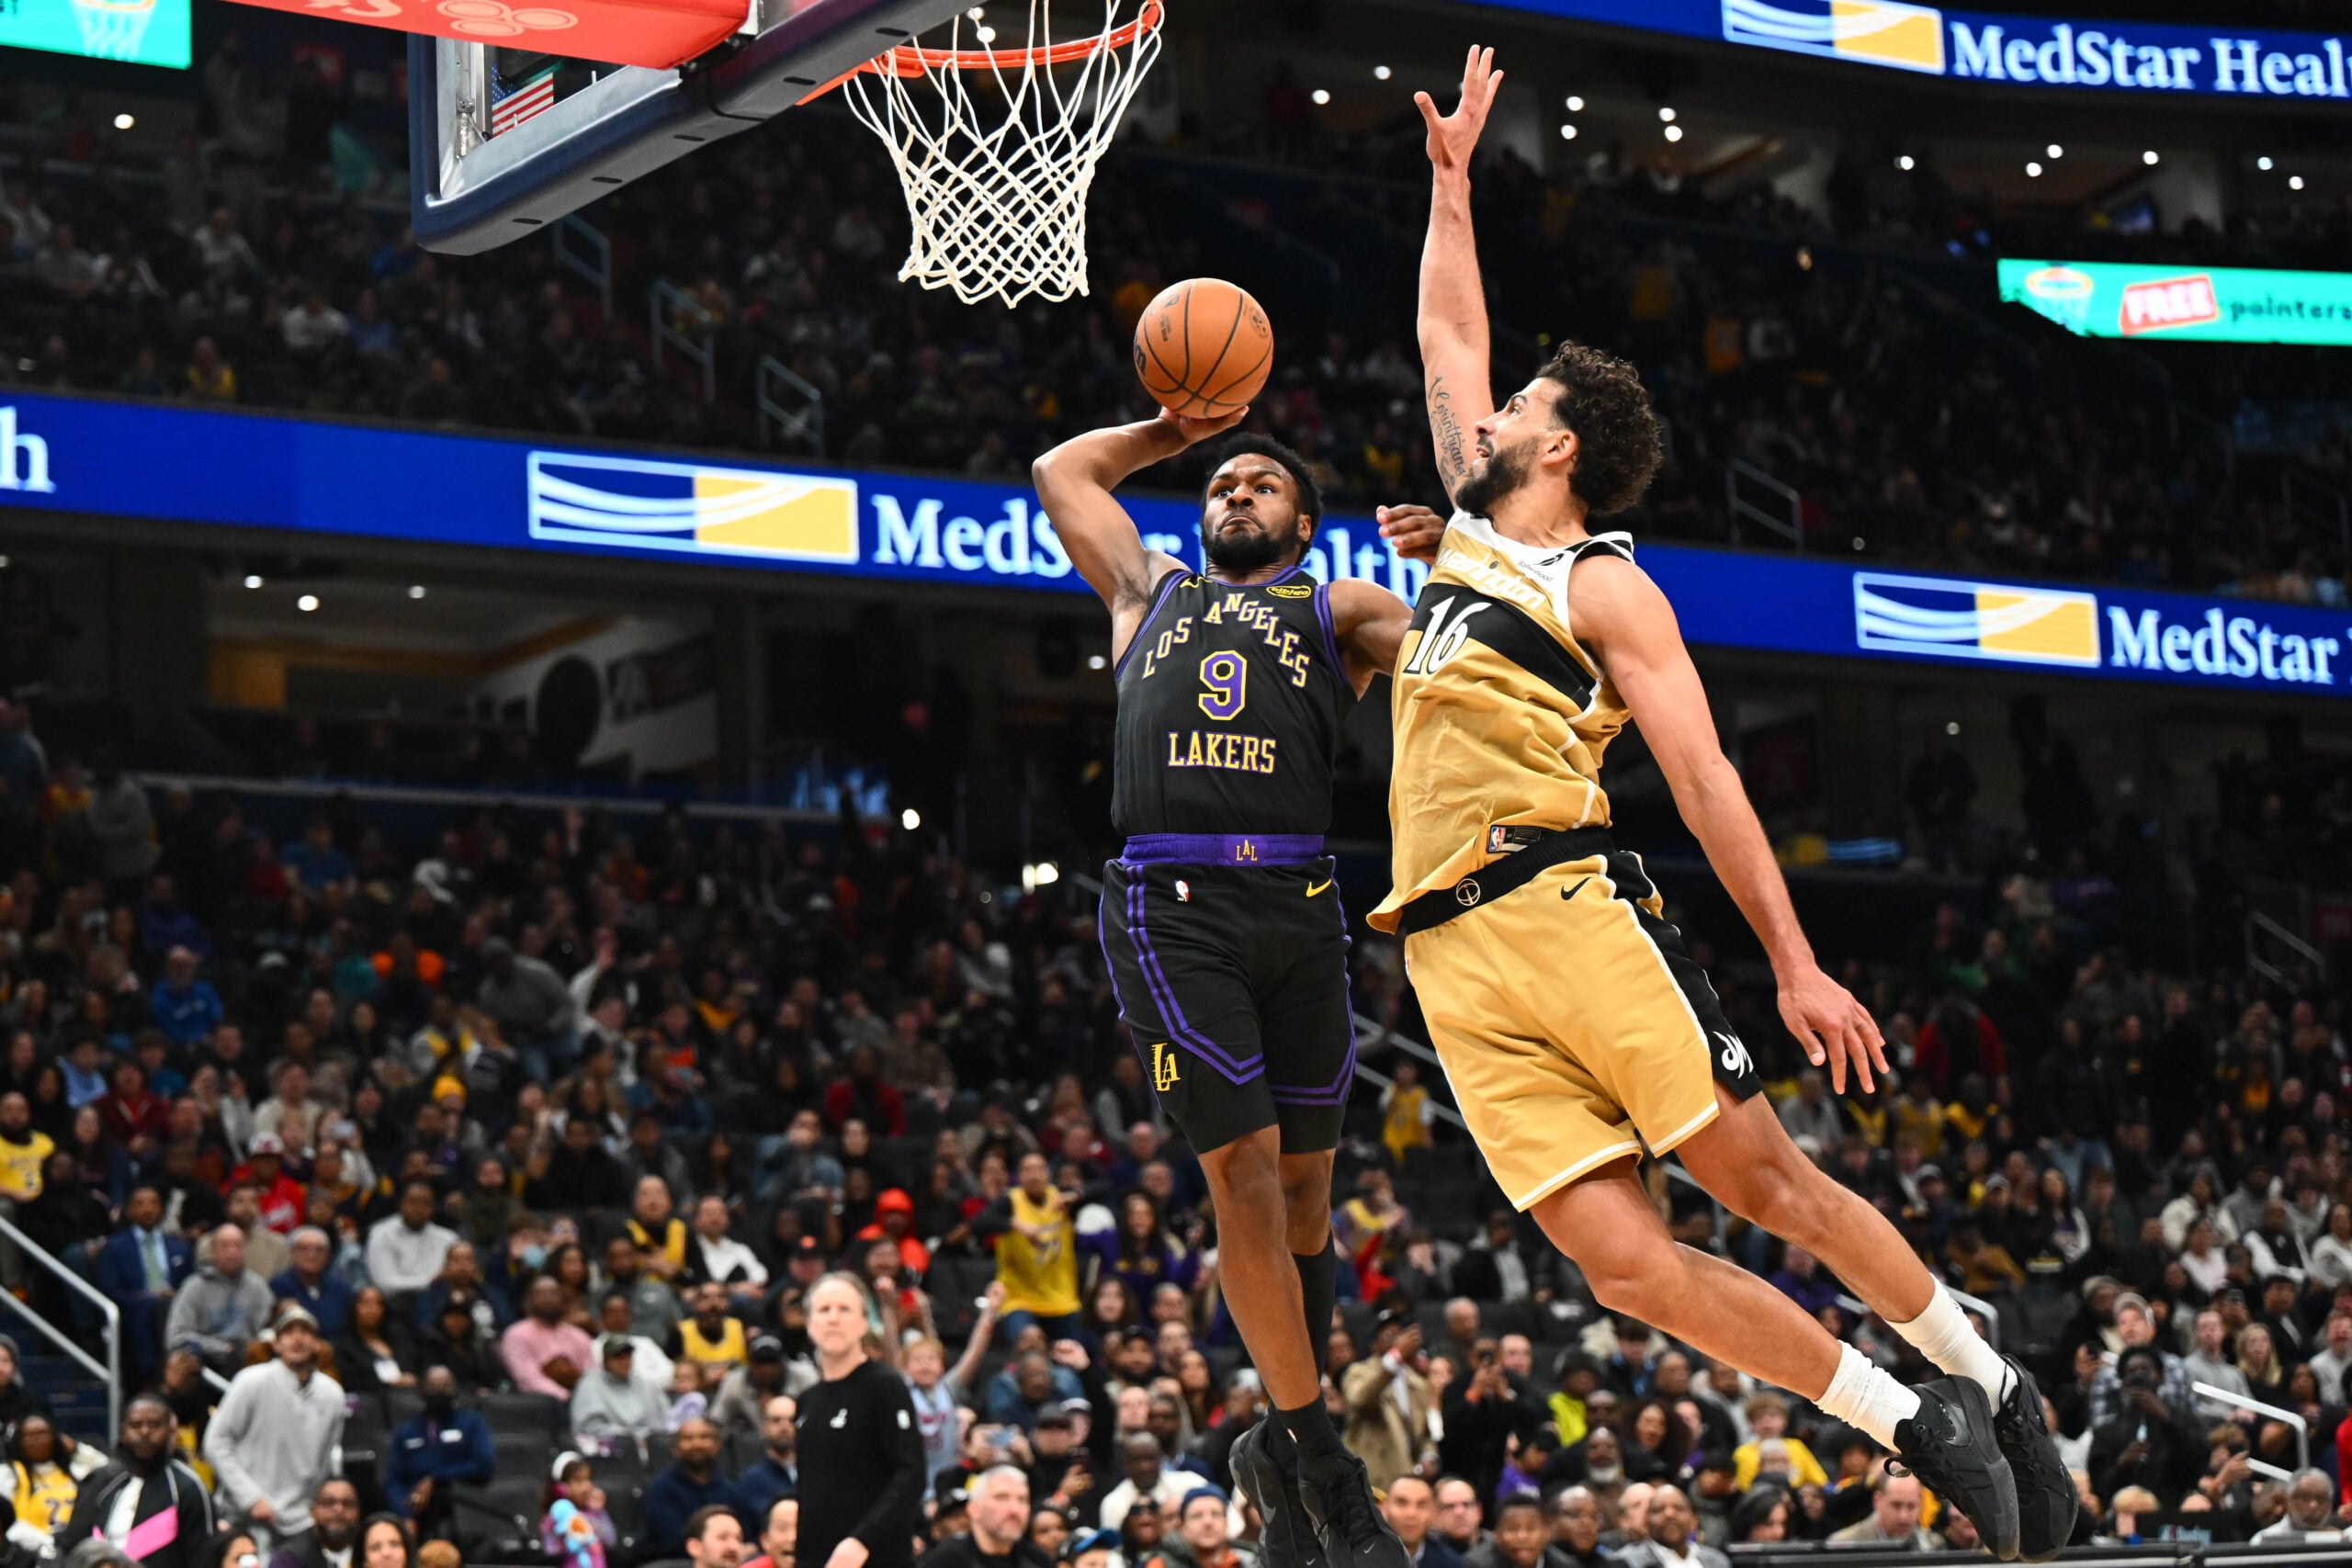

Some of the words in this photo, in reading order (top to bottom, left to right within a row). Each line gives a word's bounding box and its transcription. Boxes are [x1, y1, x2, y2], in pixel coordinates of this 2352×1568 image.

[1950, 20, 2201, 90] MedStar
[2209, 37, 2352, 98] Heal
[1141, 616, 1193, 680] LOS
[1204, 592, 1311, 688] ANGELES
[1403, 590, 1492, 674] 16
[2107, 605, 2340, 685] MedStar
[1198, 649, 1248, 721] 9
[1168, 730, 1277, 774] LAKERS
[1236, 839, 1258, 862] LAL
[1150, 1043, 1182, 1092] LA
